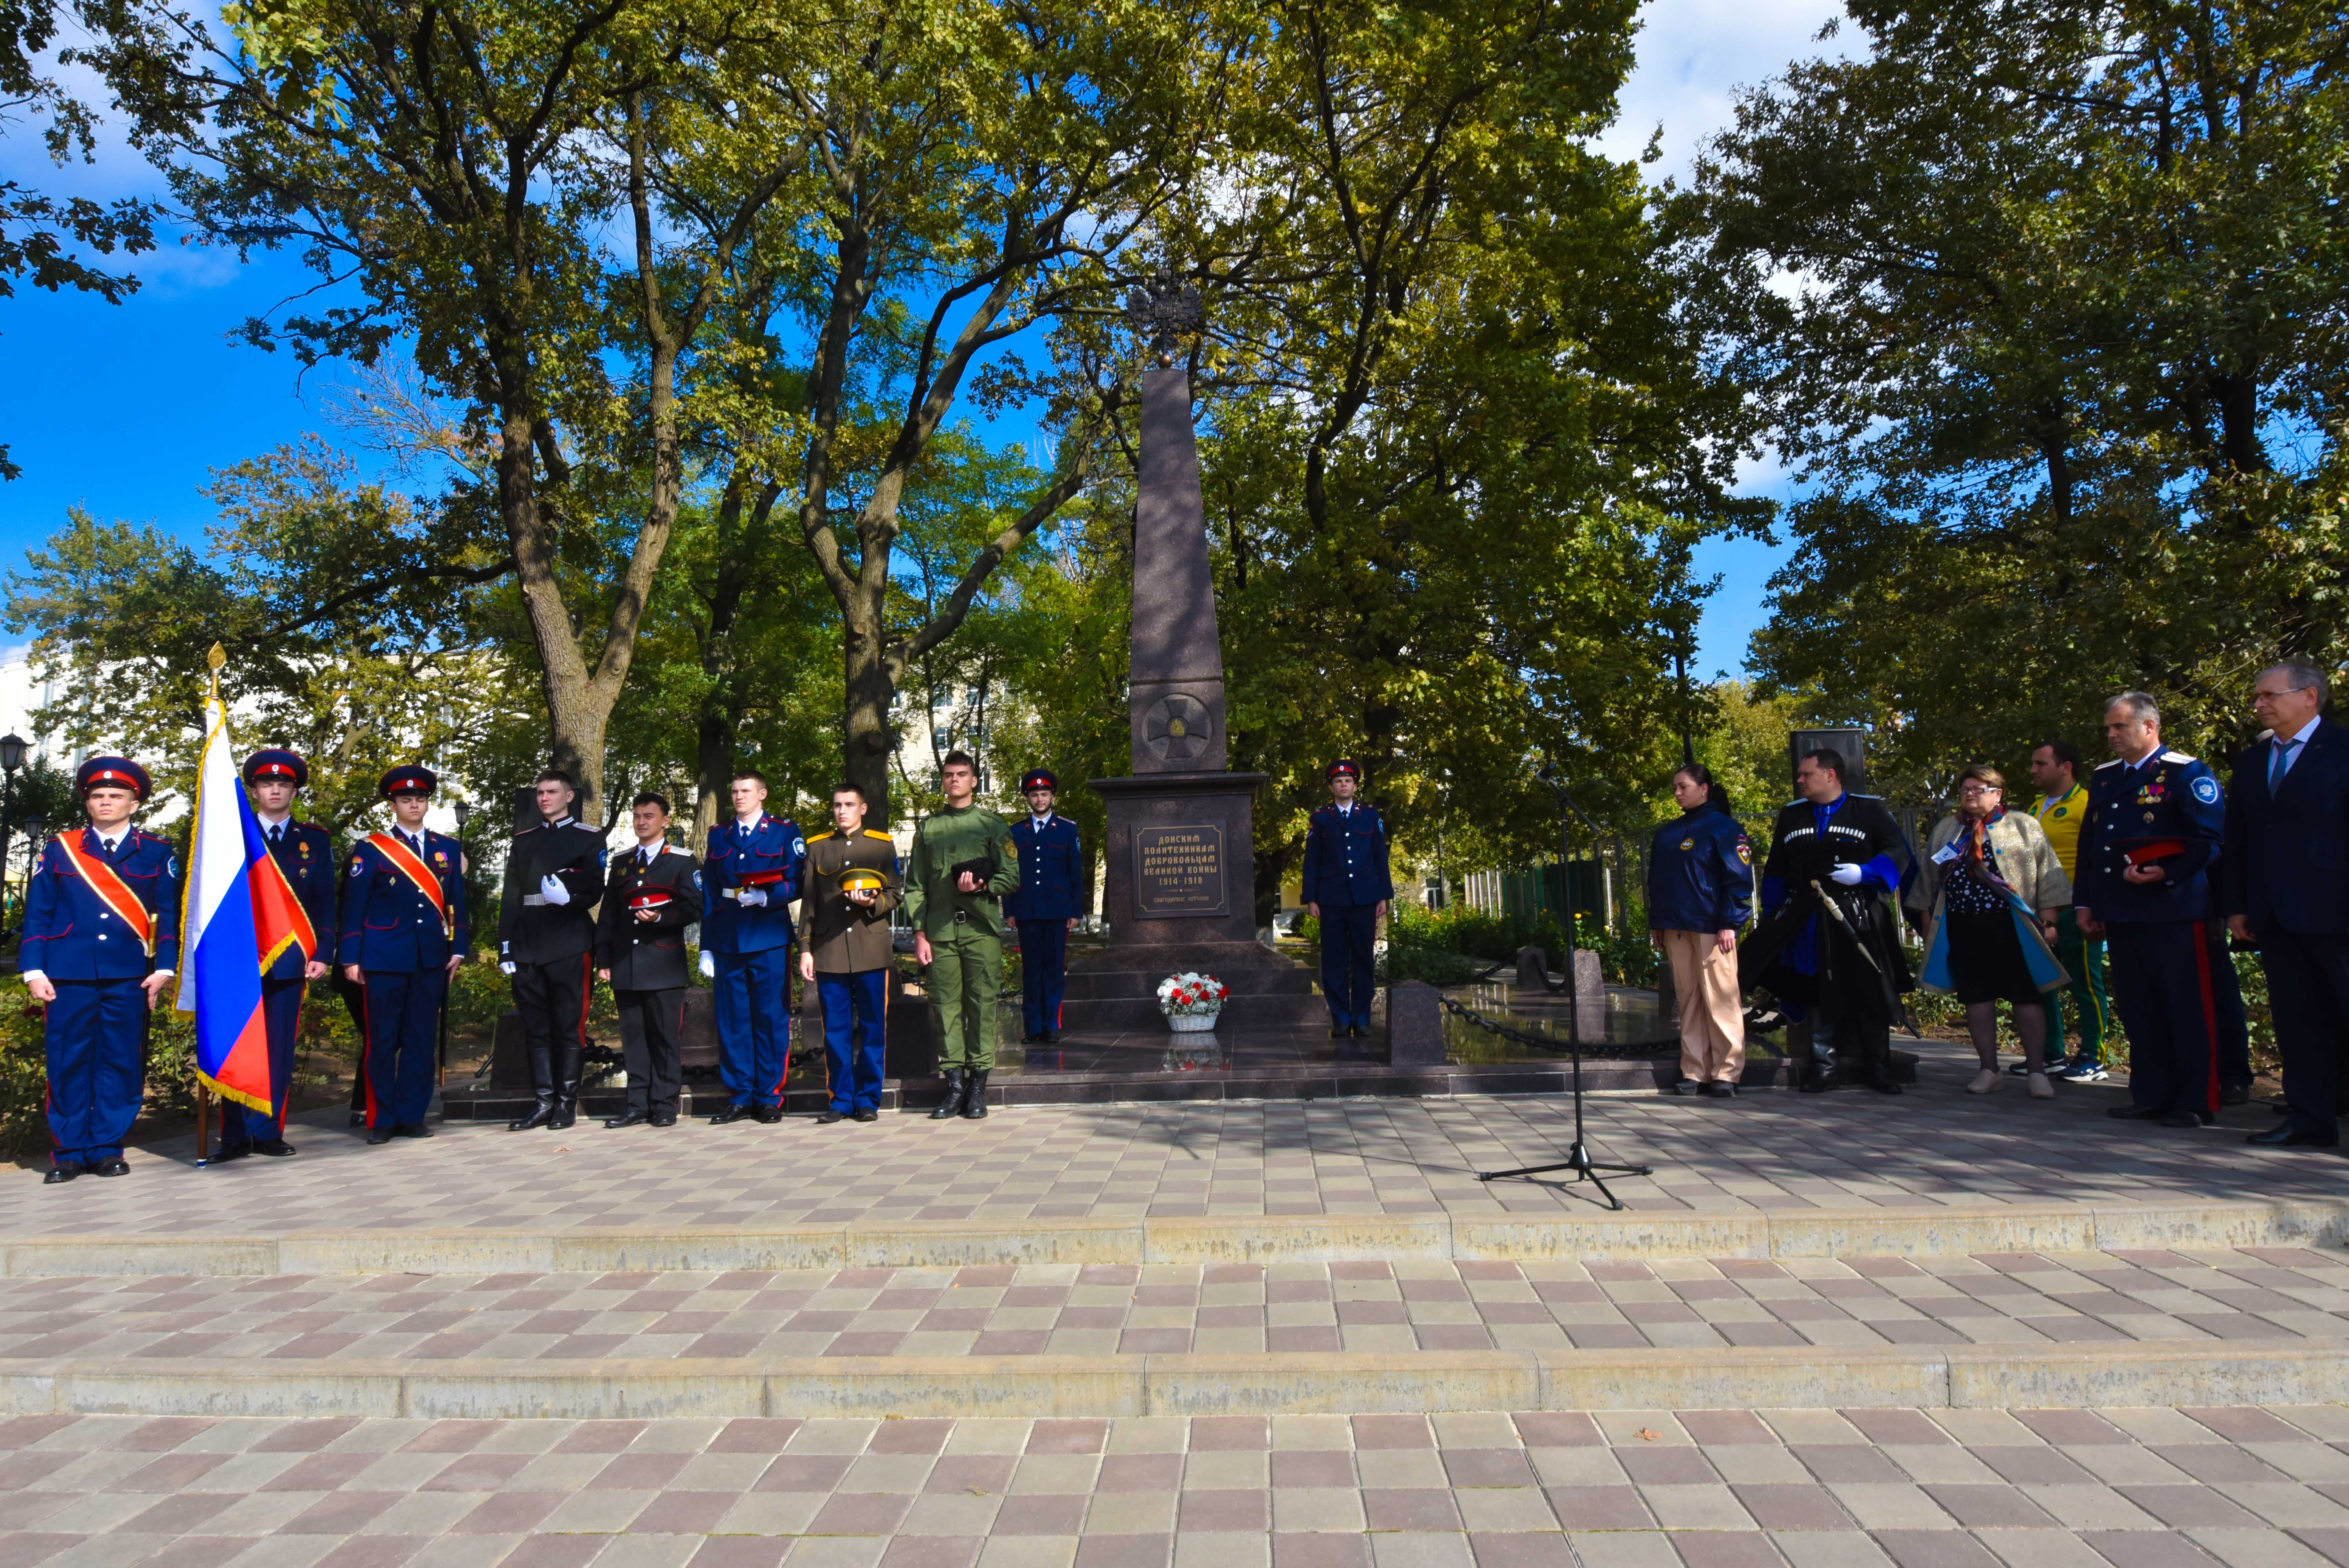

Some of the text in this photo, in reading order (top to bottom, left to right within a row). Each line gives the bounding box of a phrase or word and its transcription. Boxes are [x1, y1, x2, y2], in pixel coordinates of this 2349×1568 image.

[1158, 835, 1199, 846] ДОНСКИМ
[1144, 845, 1215, 854] ПОЛИТЕХНИКАМ
[1145, 855, 1215, 867] ДОБРОВОЛЬЦАМ
[1144, 865, 1217, 875] ВЕЛИКОЙ ВОЙНЫ
